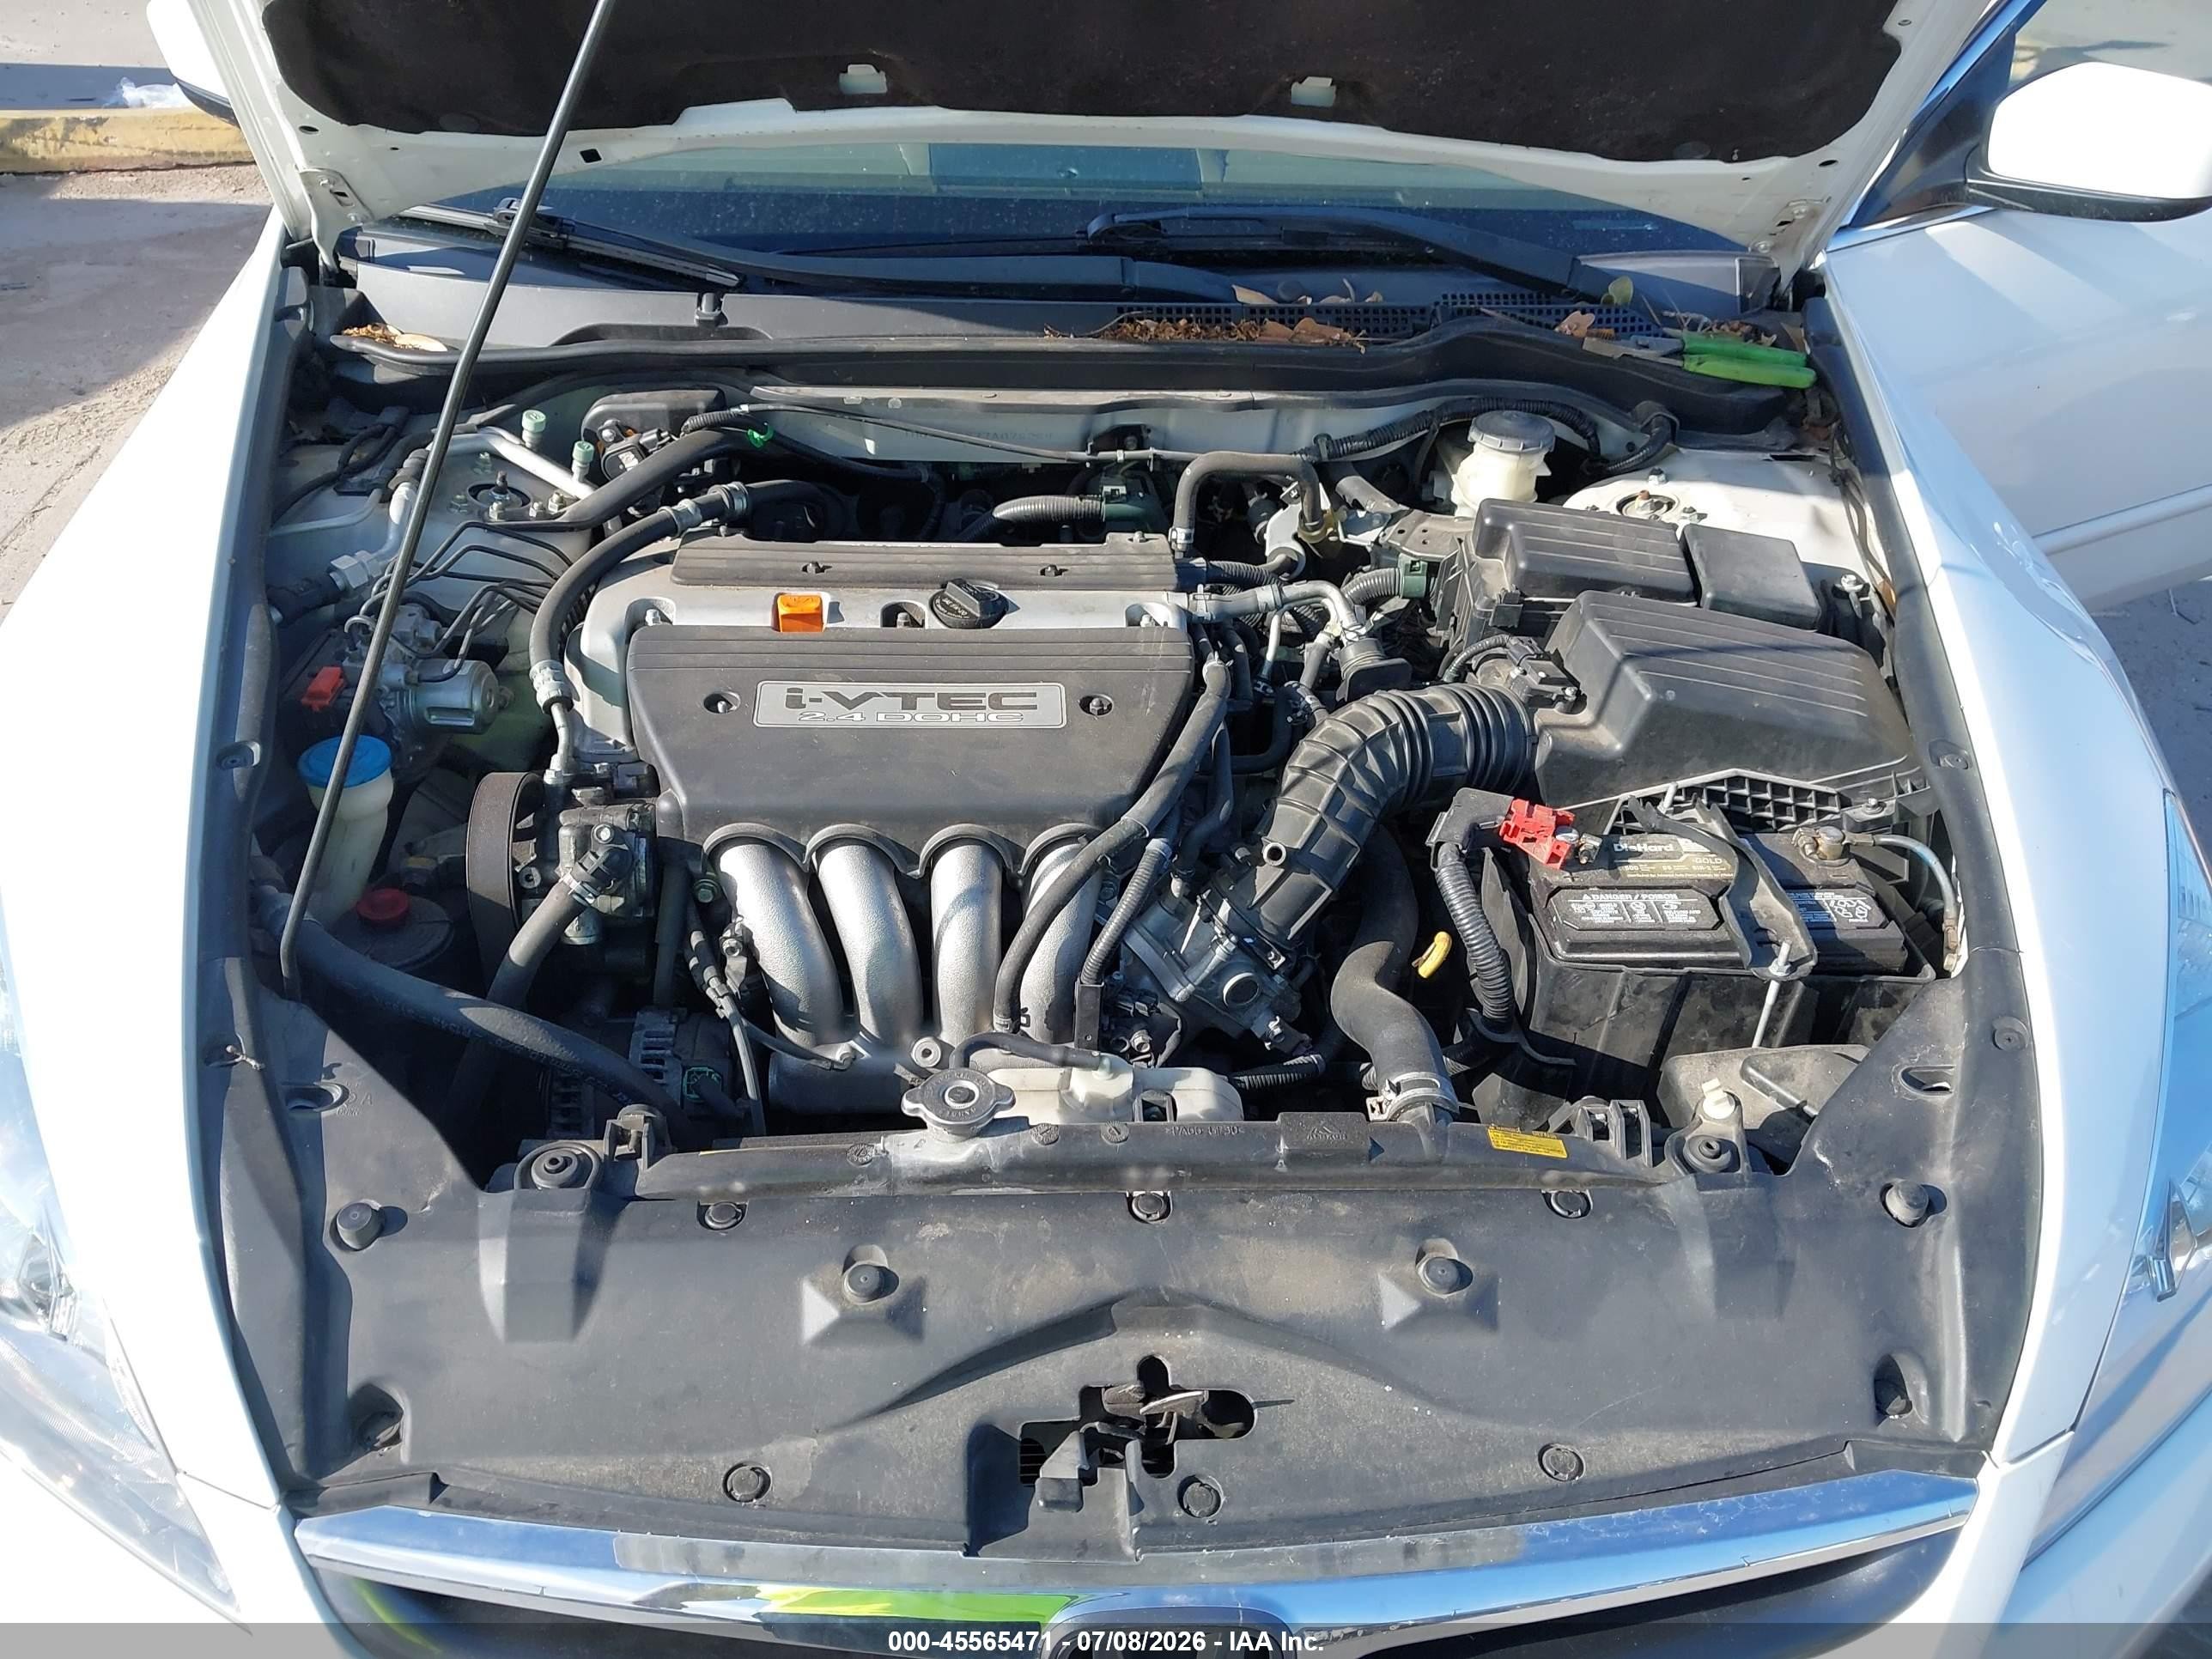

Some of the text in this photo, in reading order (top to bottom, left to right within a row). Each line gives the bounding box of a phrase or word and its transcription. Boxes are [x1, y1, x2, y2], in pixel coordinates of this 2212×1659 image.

[785, 687, 1037, 711] i-VTEC
[799, 712, 1024, 723] 2.4 DOHC
[1613, 843, 1674, 853] DieHard
